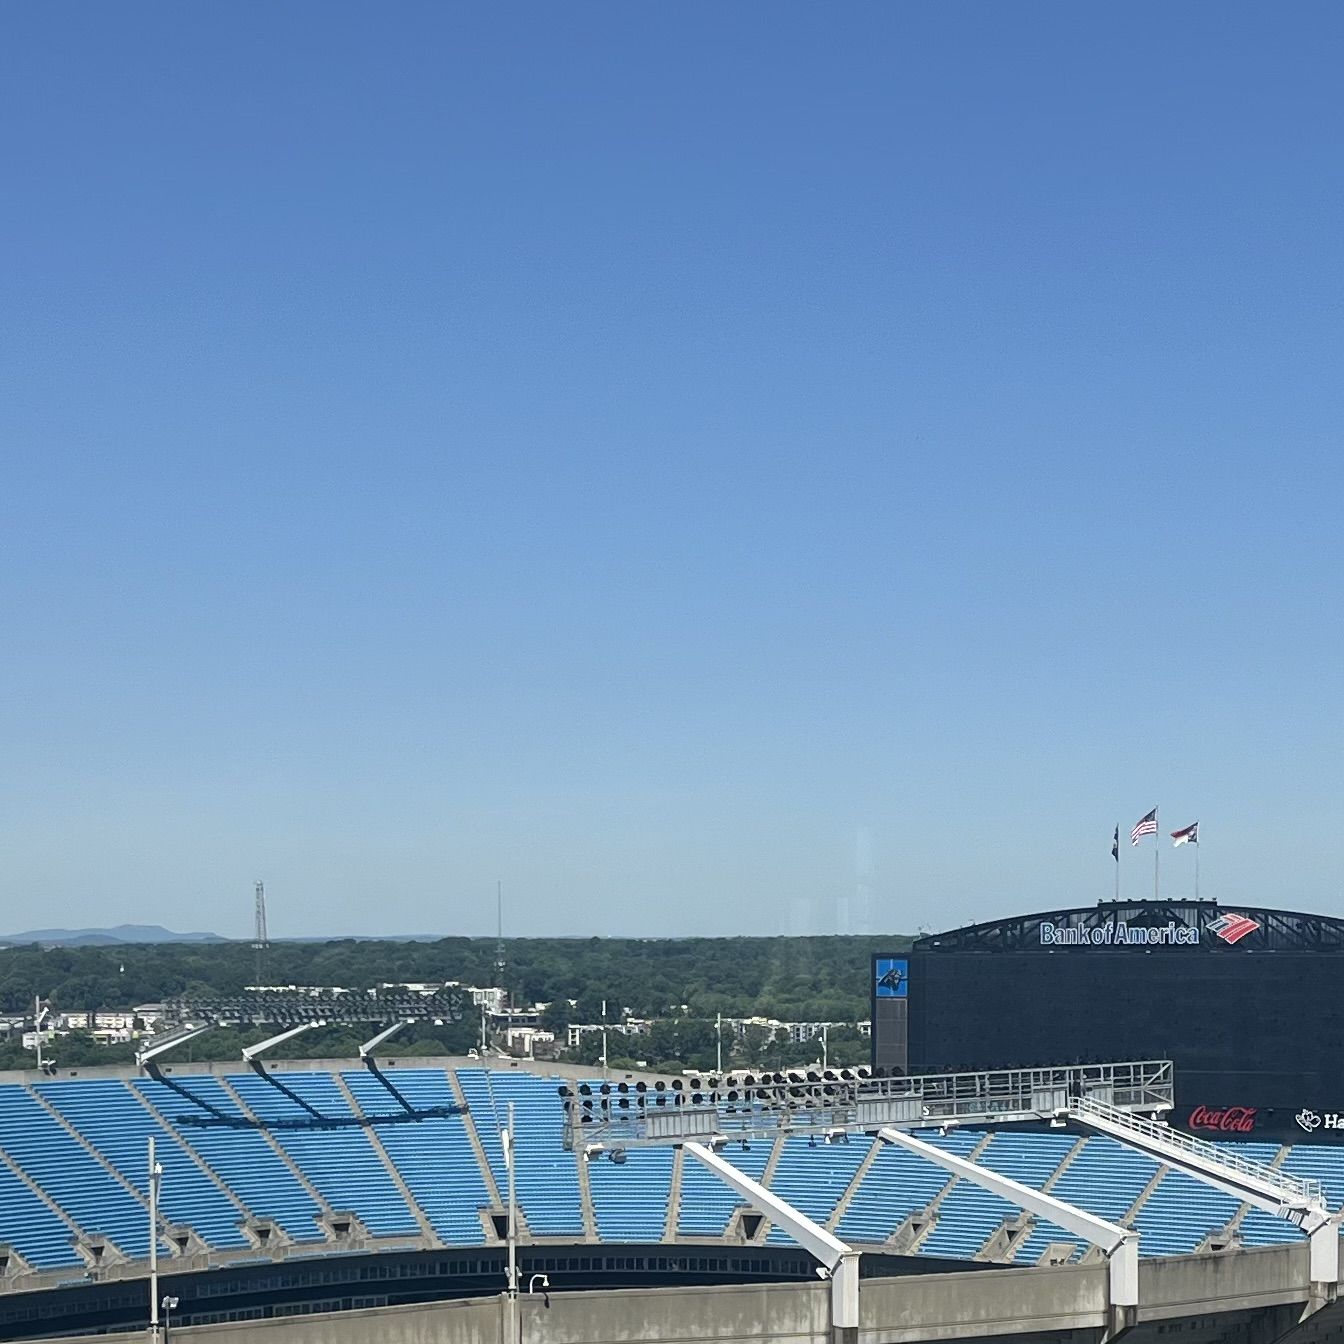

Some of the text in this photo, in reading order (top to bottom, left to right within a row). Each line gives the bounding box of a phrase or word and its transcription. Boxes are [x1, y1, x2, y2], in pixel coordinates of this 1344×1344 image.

[1040, 921, 1199, 945] Bank of America
